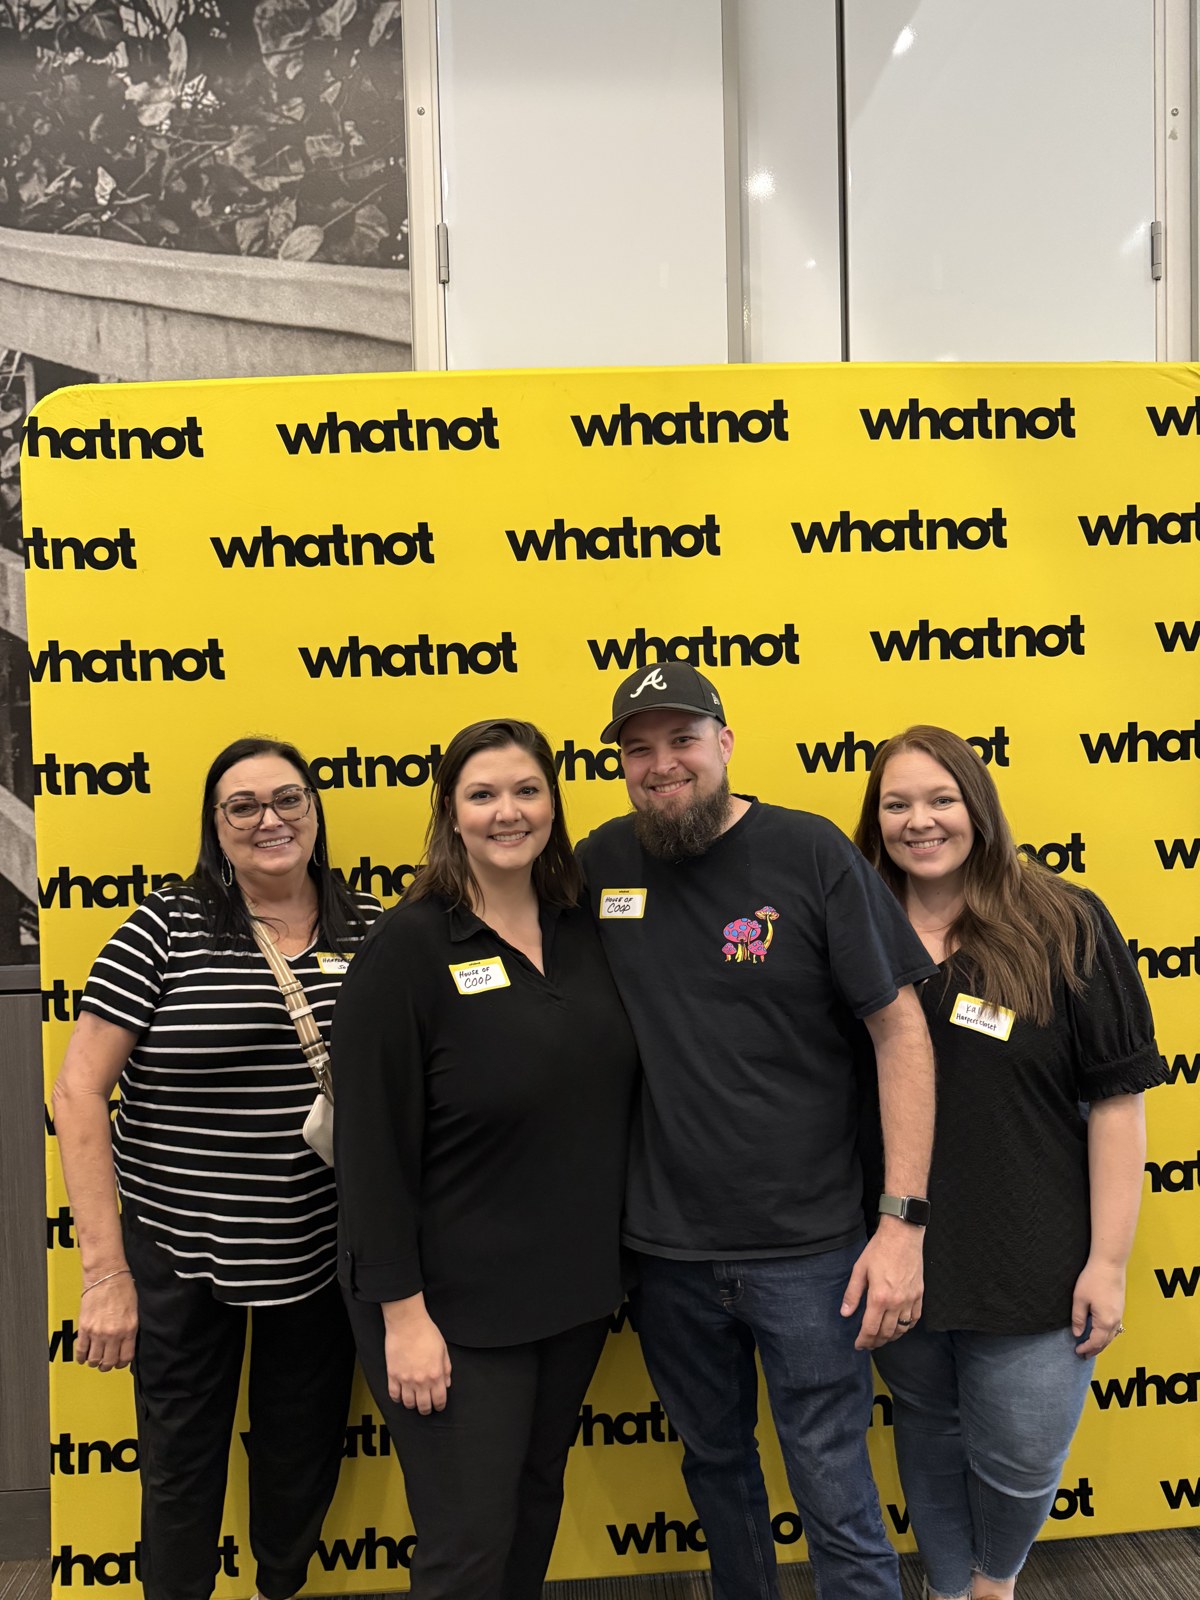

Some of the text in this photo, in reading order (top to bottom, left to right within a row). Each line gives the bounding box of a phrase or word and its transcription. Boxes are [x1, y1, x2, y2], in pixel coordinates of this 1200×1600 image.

[23, 417, 204, 460] hatnot
[276, 408, 500, 455] whatnot
[571, 399, 789, 447] whatnot
[860, 397, 1076, 440] whatnot
[210, 522, 435, 568] whatnot
[504, 515, 721, 562] whatnot
[791, 508, 1007, 554] whatnot
[298, 632, 518, 679] whatnot
[587, 624, 800, 670] whatnot
[870, 615, 1085, 662] whatnot
[630, 667, 668, 699] A
[464, 973, 492, 989] COOP
